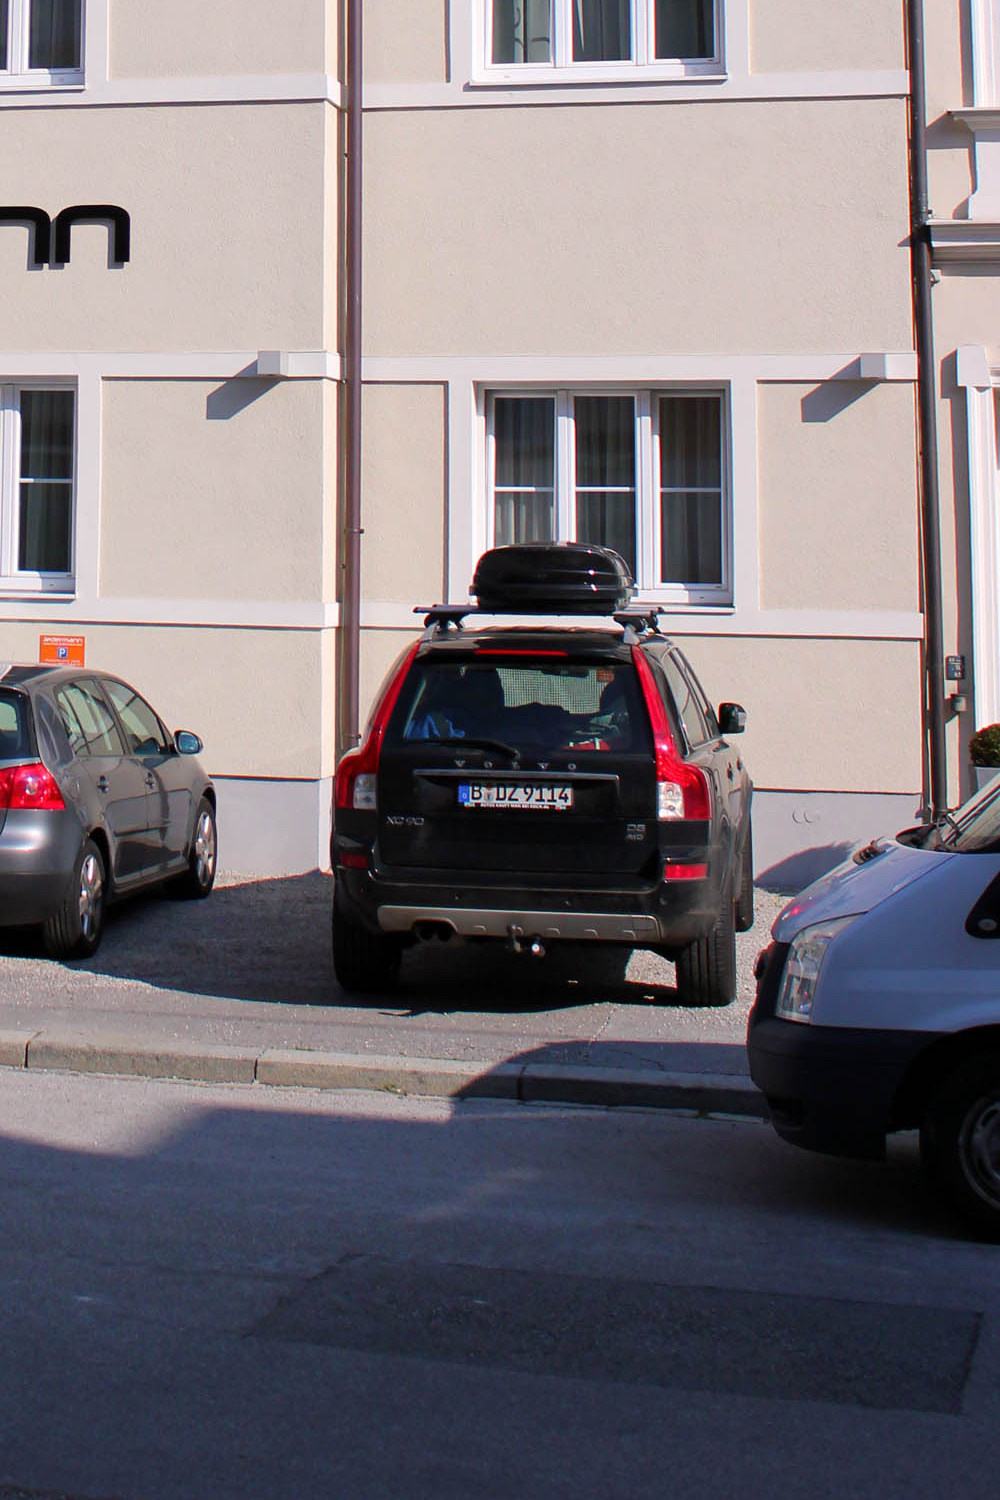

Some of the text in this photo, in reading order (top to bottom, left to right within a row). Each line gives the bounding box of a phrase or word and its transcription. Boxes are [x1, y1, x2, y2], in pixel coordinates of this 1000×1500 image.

[44, 636, 84, 644] Jedermann
[471, 784, 570, 803] B DZ 9114
